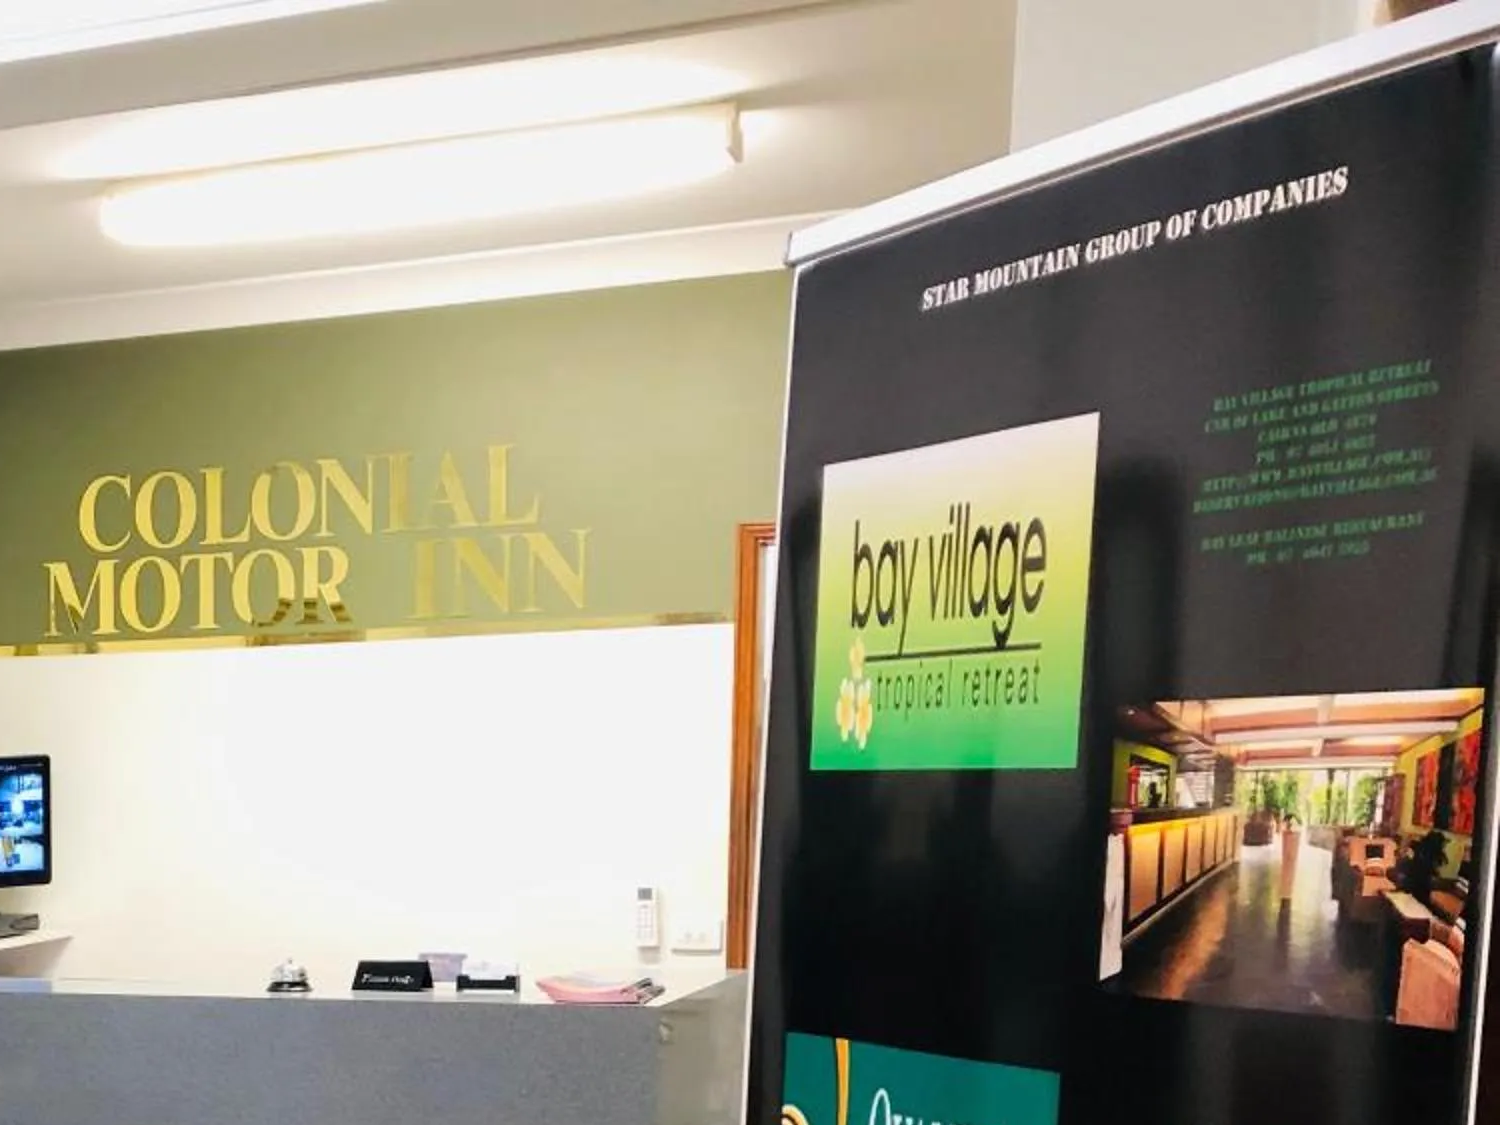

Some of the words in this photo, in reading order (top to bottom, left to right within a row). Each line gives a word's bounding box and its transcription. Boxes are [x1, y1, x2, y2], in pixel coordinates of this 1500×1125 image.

[921, 277, 970, 312] STAR
[974, 244, 1081, 295] MOUNTAIN
[1085, 220, 1162, 264] GROUP
[1166, 210, 1197, 241] OF
[1201, 166, 1349, 232] COMPANIES
[79, 443, 541, 553] COLONIAL
[44, 545, 353, 638] MOTOR
[408, 527, 593, 620] INN
[851, 519, 919, 657] bay
[928, 501, 1047, 650] village
[876, 659, 953, 721] tropical
[962, 659, 1041, 706] retreat
